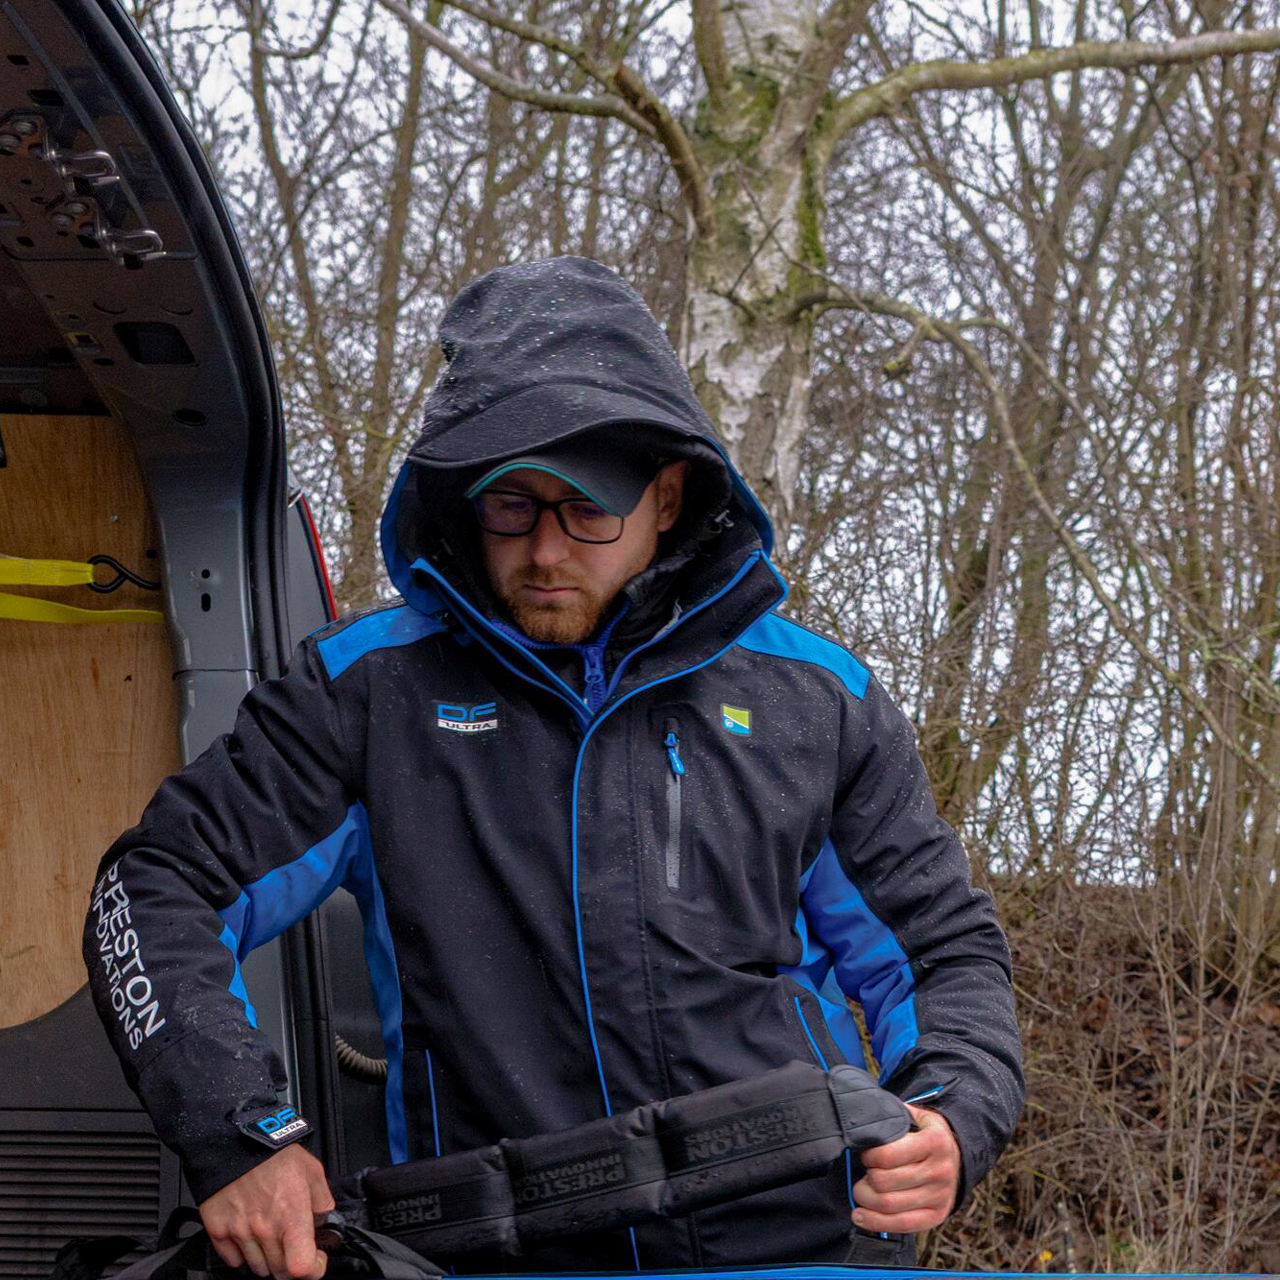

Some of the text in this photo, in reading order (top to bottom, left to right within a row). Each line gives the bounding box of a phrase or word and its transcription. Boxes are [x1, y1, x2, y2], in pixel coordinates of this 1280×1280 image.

[445, 721, 492, 731] ULTRA
[104, 860, 166, 1039] PRESTON
[273, 1121, 304, 1138] ULTRA
